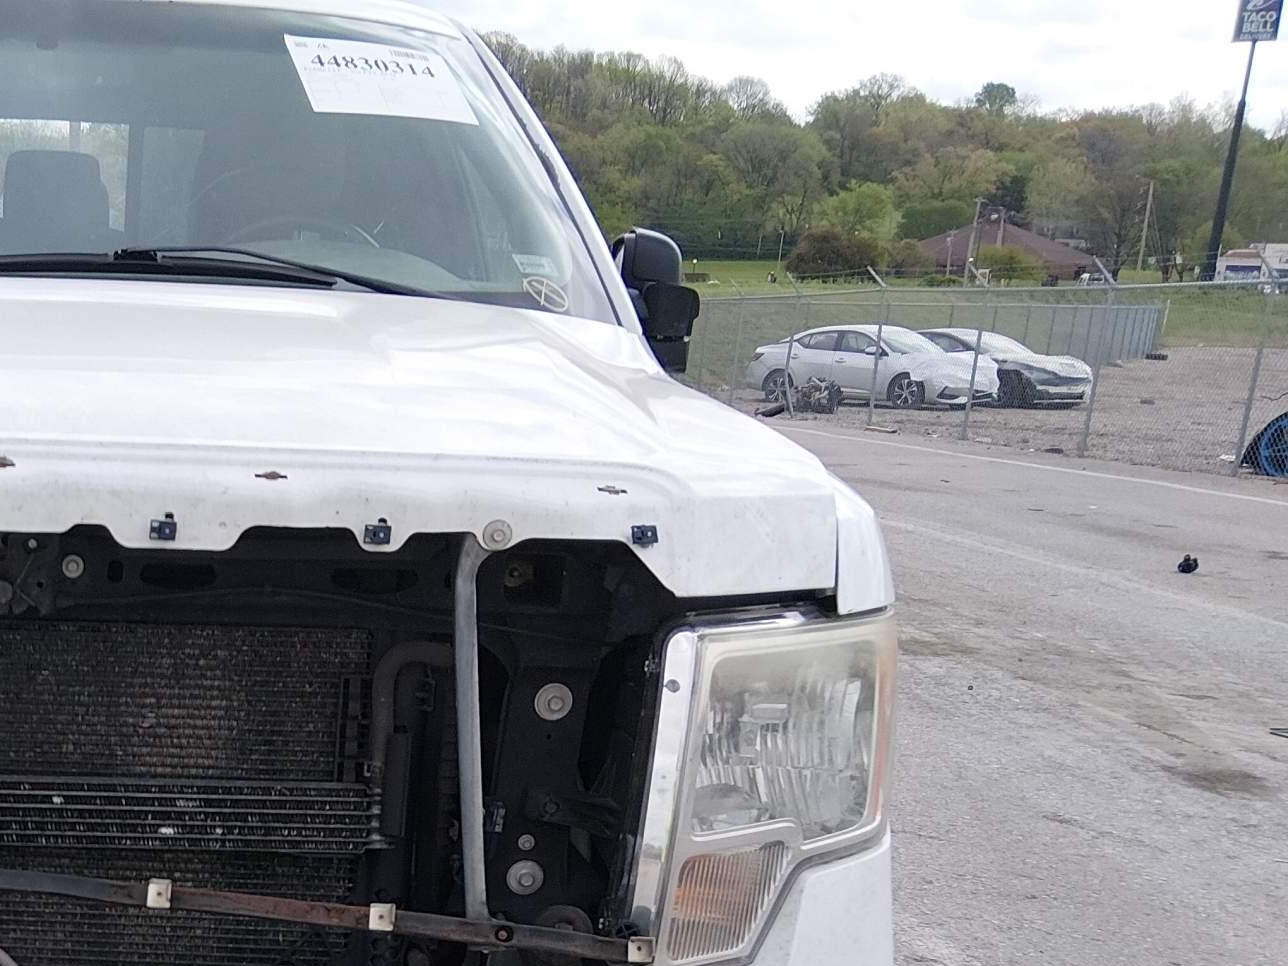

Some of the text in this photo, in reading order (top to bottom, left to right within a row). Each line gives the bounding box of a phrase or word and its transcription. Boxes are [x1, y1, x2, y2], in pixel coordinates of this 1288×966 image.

[1242, 10, 1277, 22] TACO
[1242, 21, 1274, 33] BELL
[311, 54, 436, 79] 44830314
